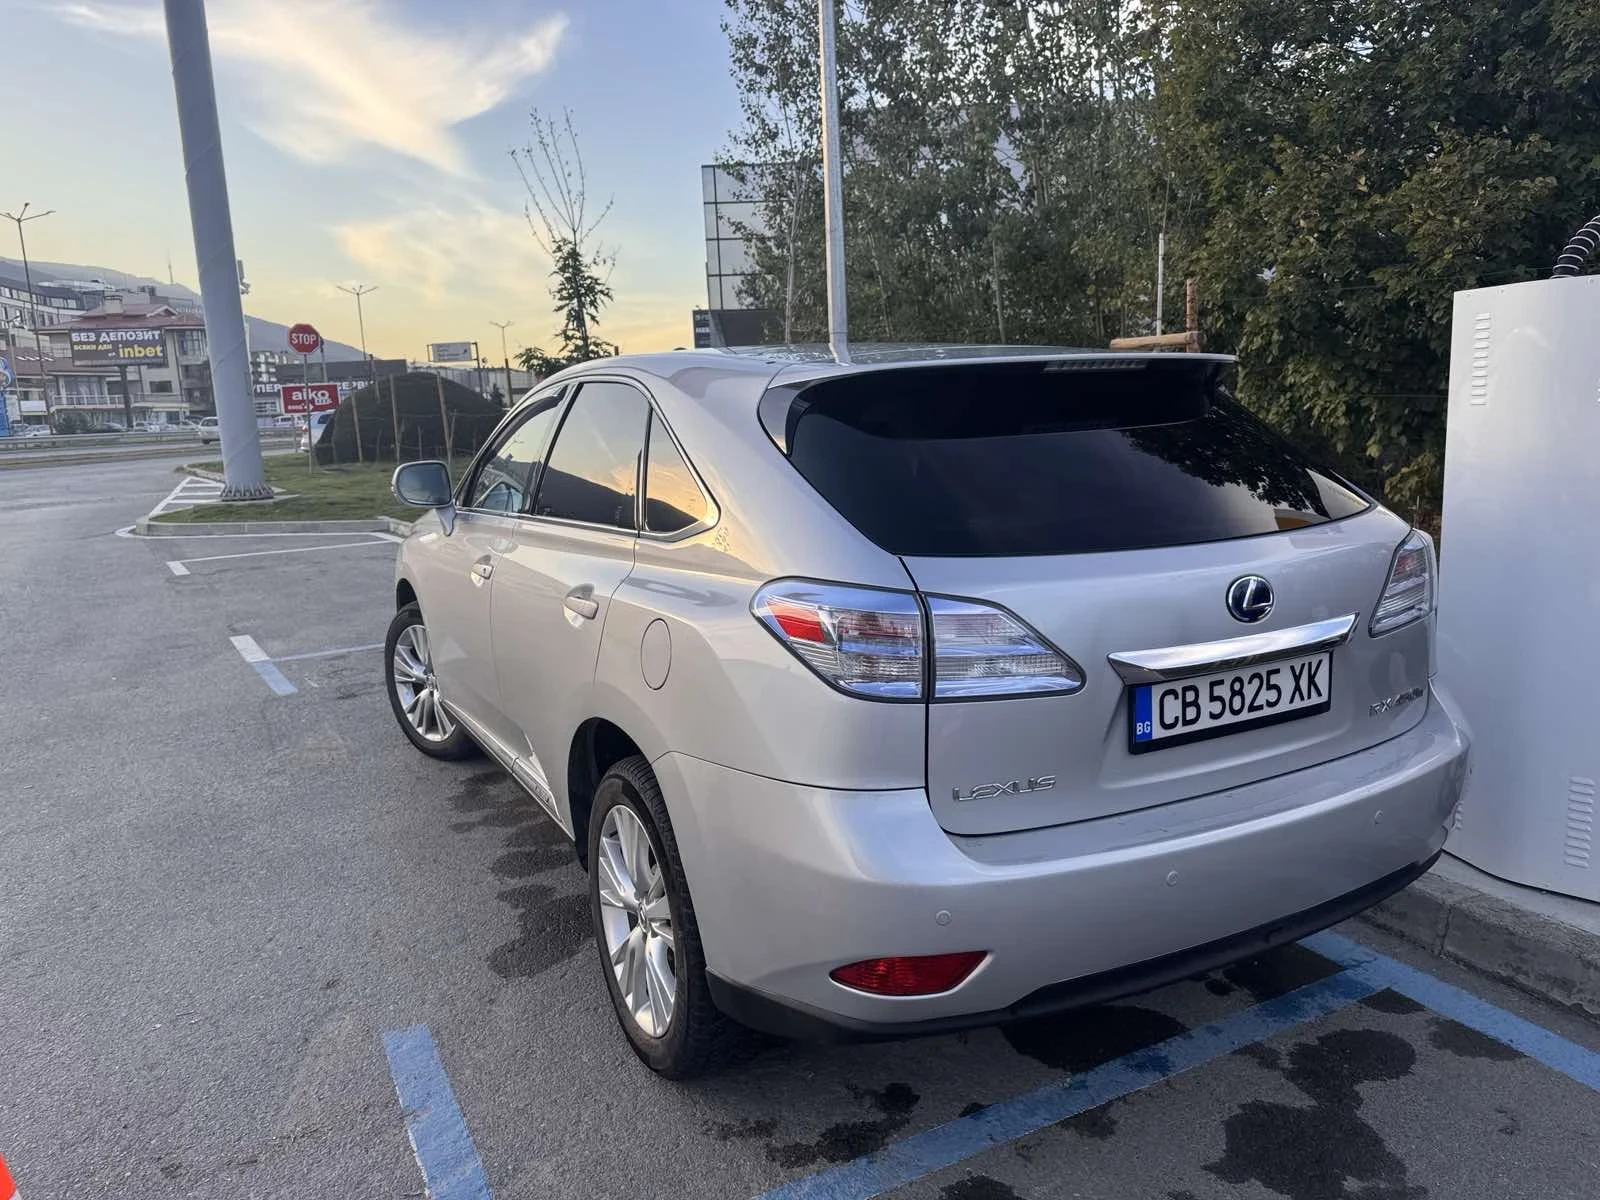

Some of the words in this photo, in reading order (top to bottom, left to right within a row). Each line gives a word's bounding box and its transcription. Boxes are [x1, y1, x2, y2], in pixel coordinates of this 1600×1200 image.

[72, 332, 96, 342] БЕЗ
[100, 330, 160, 343] ДЕПОЗИТ
[292, 333, 317, 345] STOP
[119, 344, 163, 358] inbet
[292, 388, 330, 401] aiko
[1159, 684, 1201, 730] CB
[1208, 668, 1282, 720] 5825
[1289, 659, 1323, 704] XK
[1136, 721, 1151, 735] BG
[953, 775, 1056, 801] LEXUS
